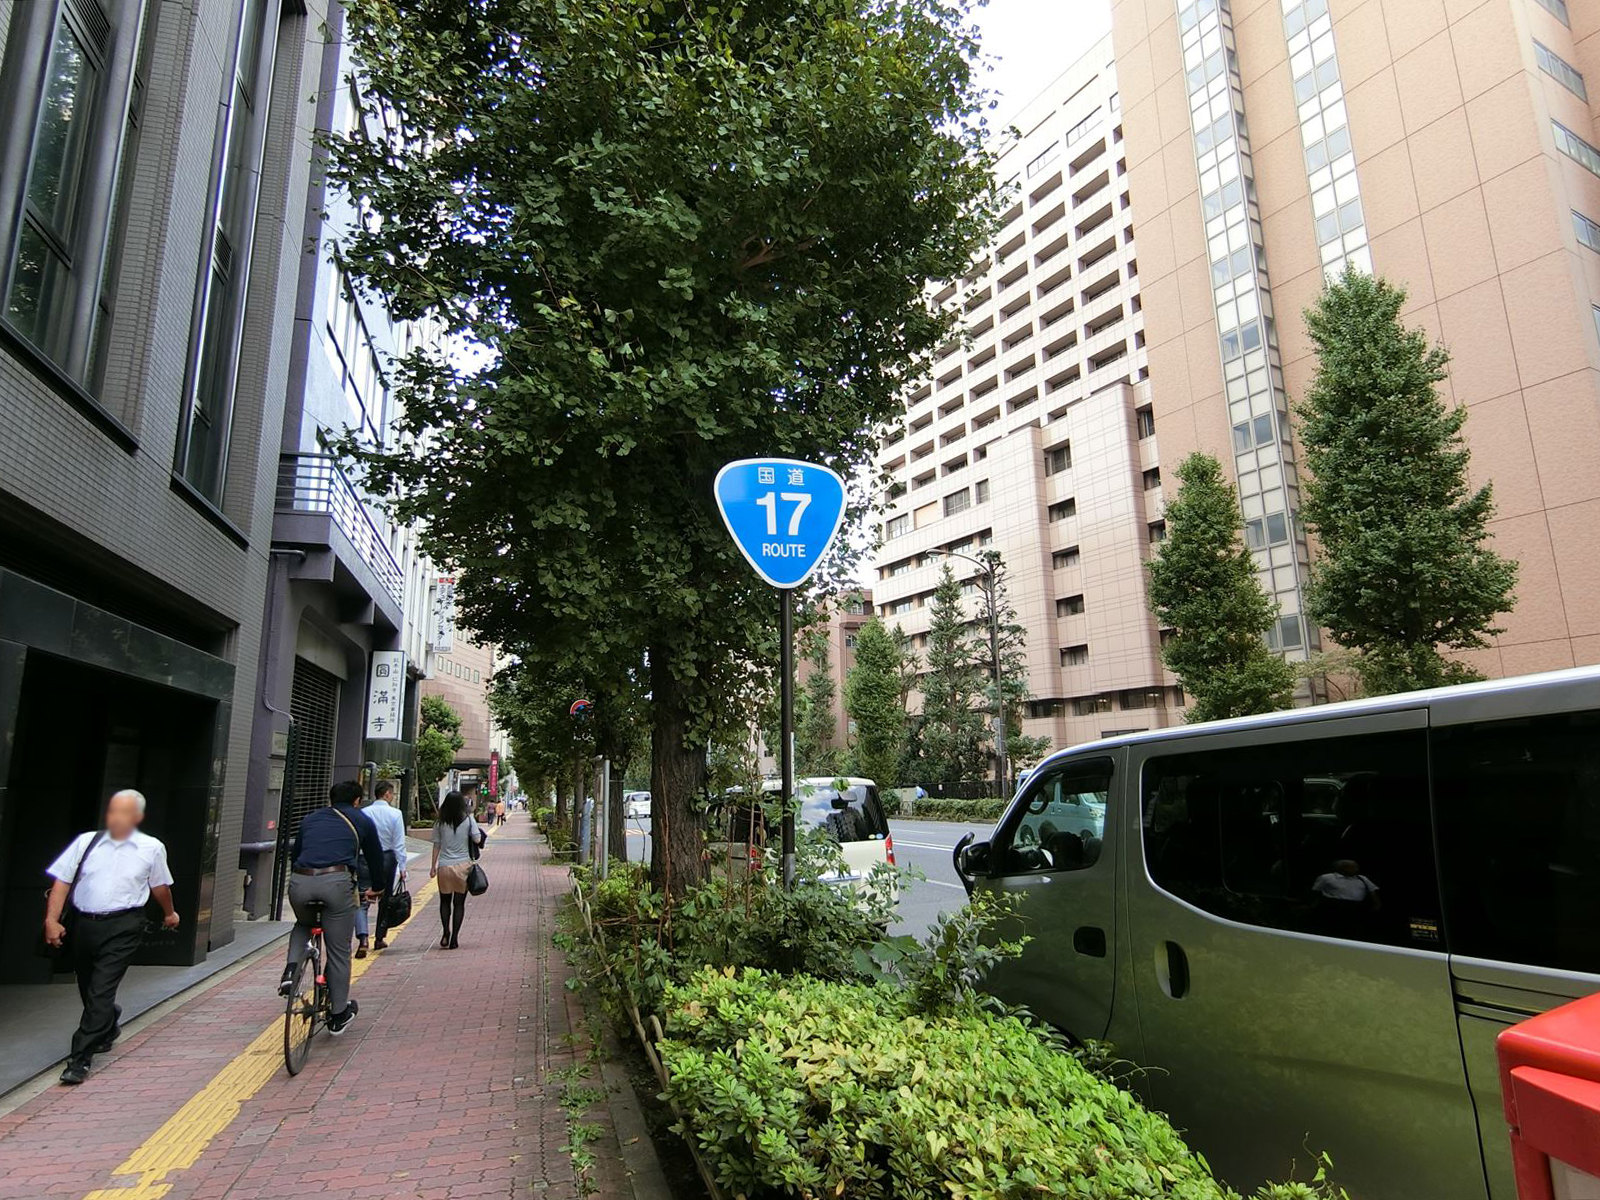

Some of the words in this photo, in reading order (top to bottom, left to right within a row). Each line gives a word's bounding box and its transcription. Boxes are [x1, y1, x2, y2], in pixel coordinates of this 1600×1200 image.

[758, 467, 804, 485] 国道
[756, 491, 812, 536] 17
[762, 543, 806, 557] ROUTE
